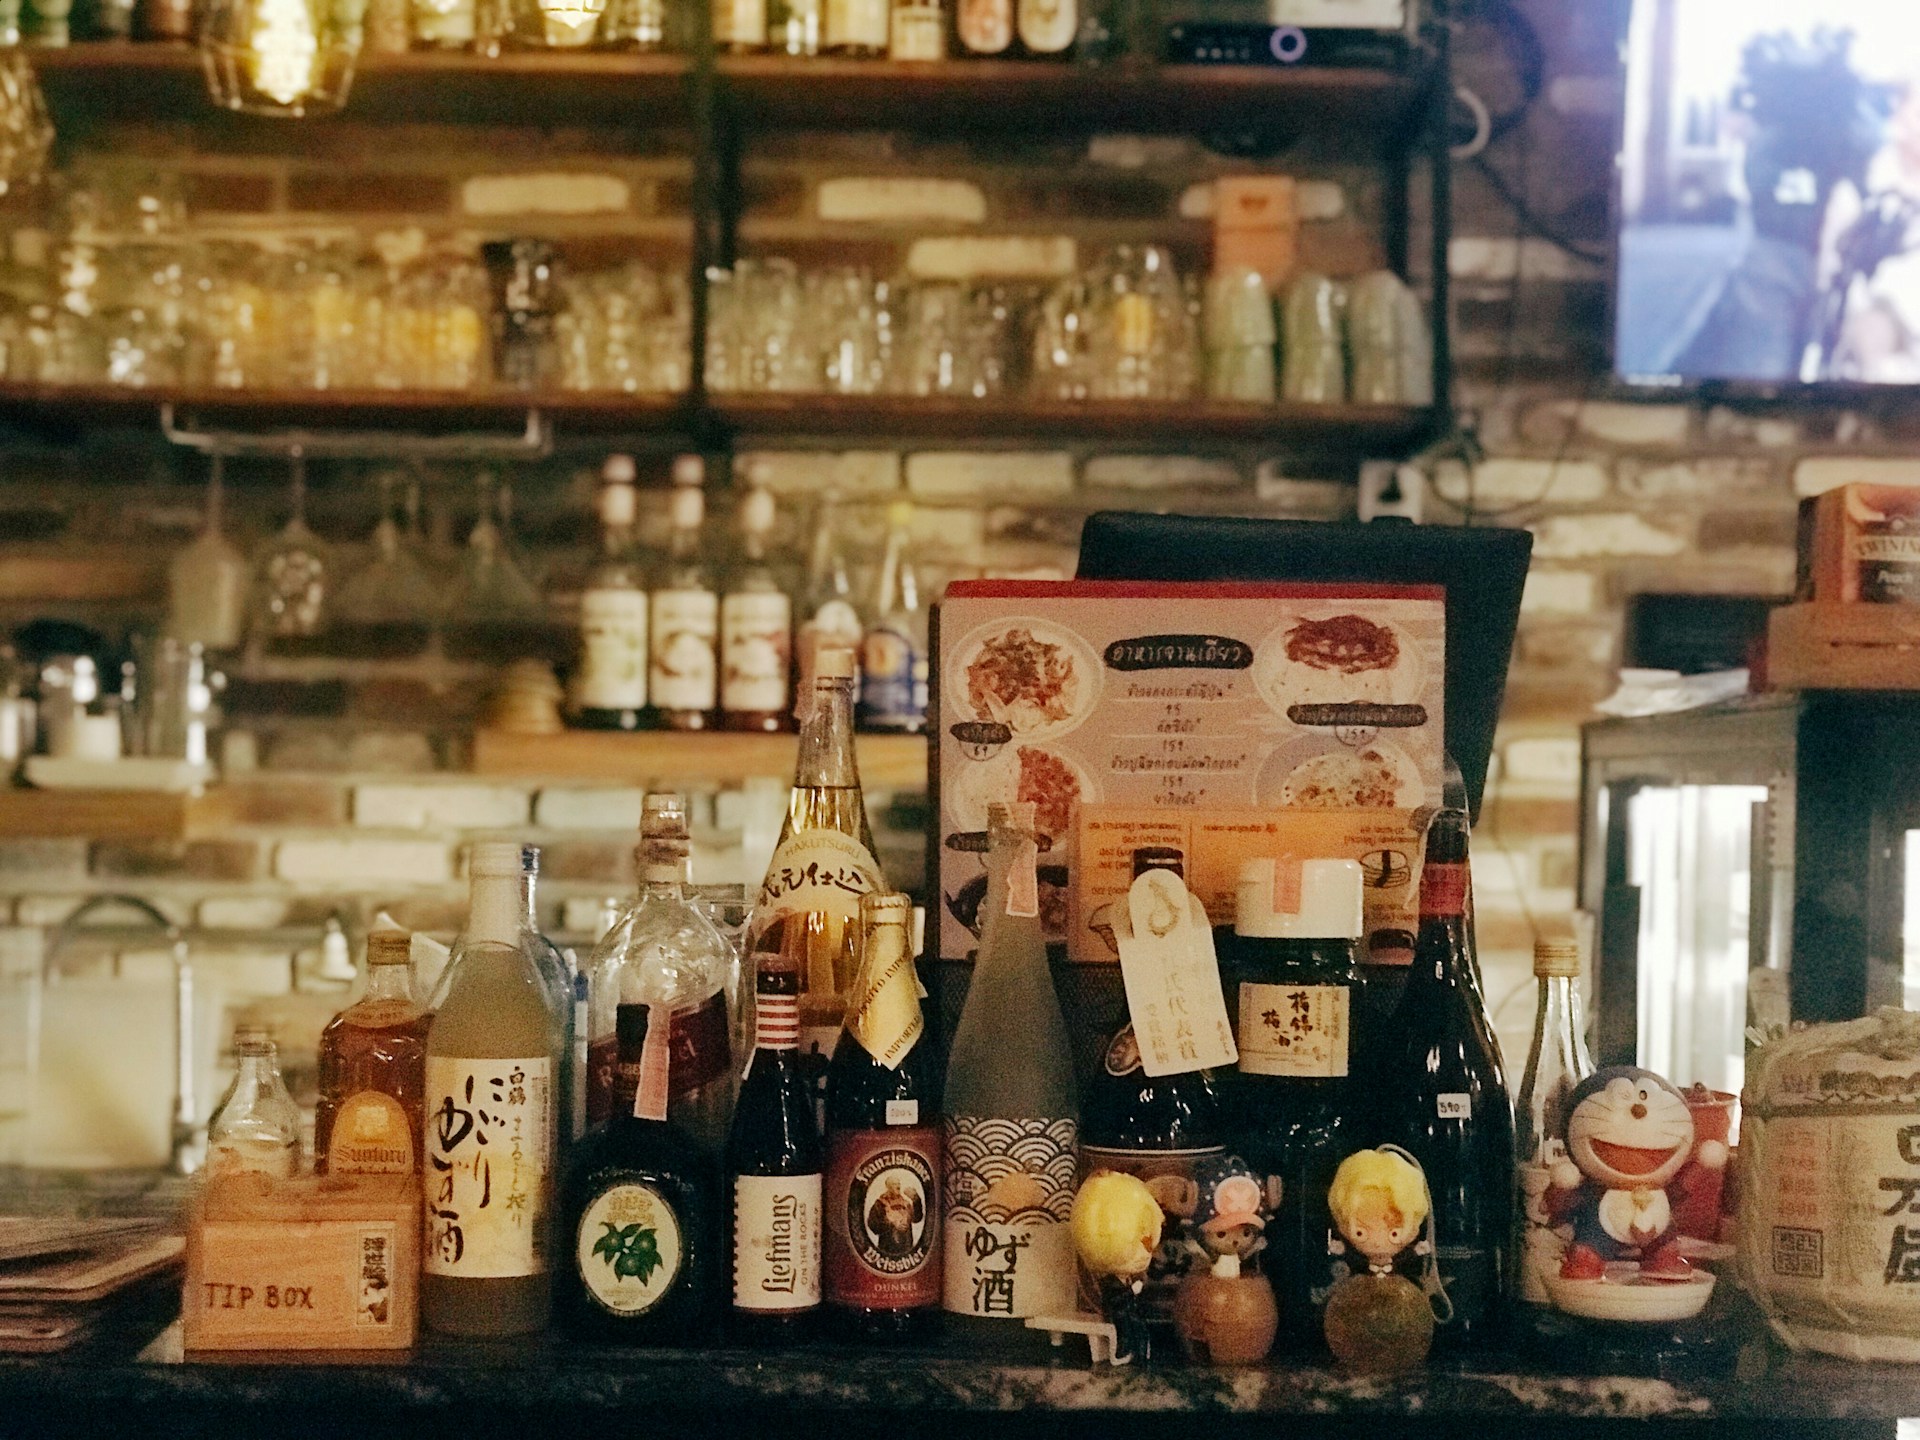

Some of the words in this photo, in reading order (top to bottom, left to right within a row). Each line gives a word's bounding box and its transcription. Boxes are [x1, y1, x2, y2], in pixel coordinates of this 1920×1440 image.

[335, 1145, 406, 1165] Suntory
[761, 1194, 797, 1294] Liefmans
[203, 1282, 254, 1309] TIP
[265, 1284, 314, 1309] BOX
